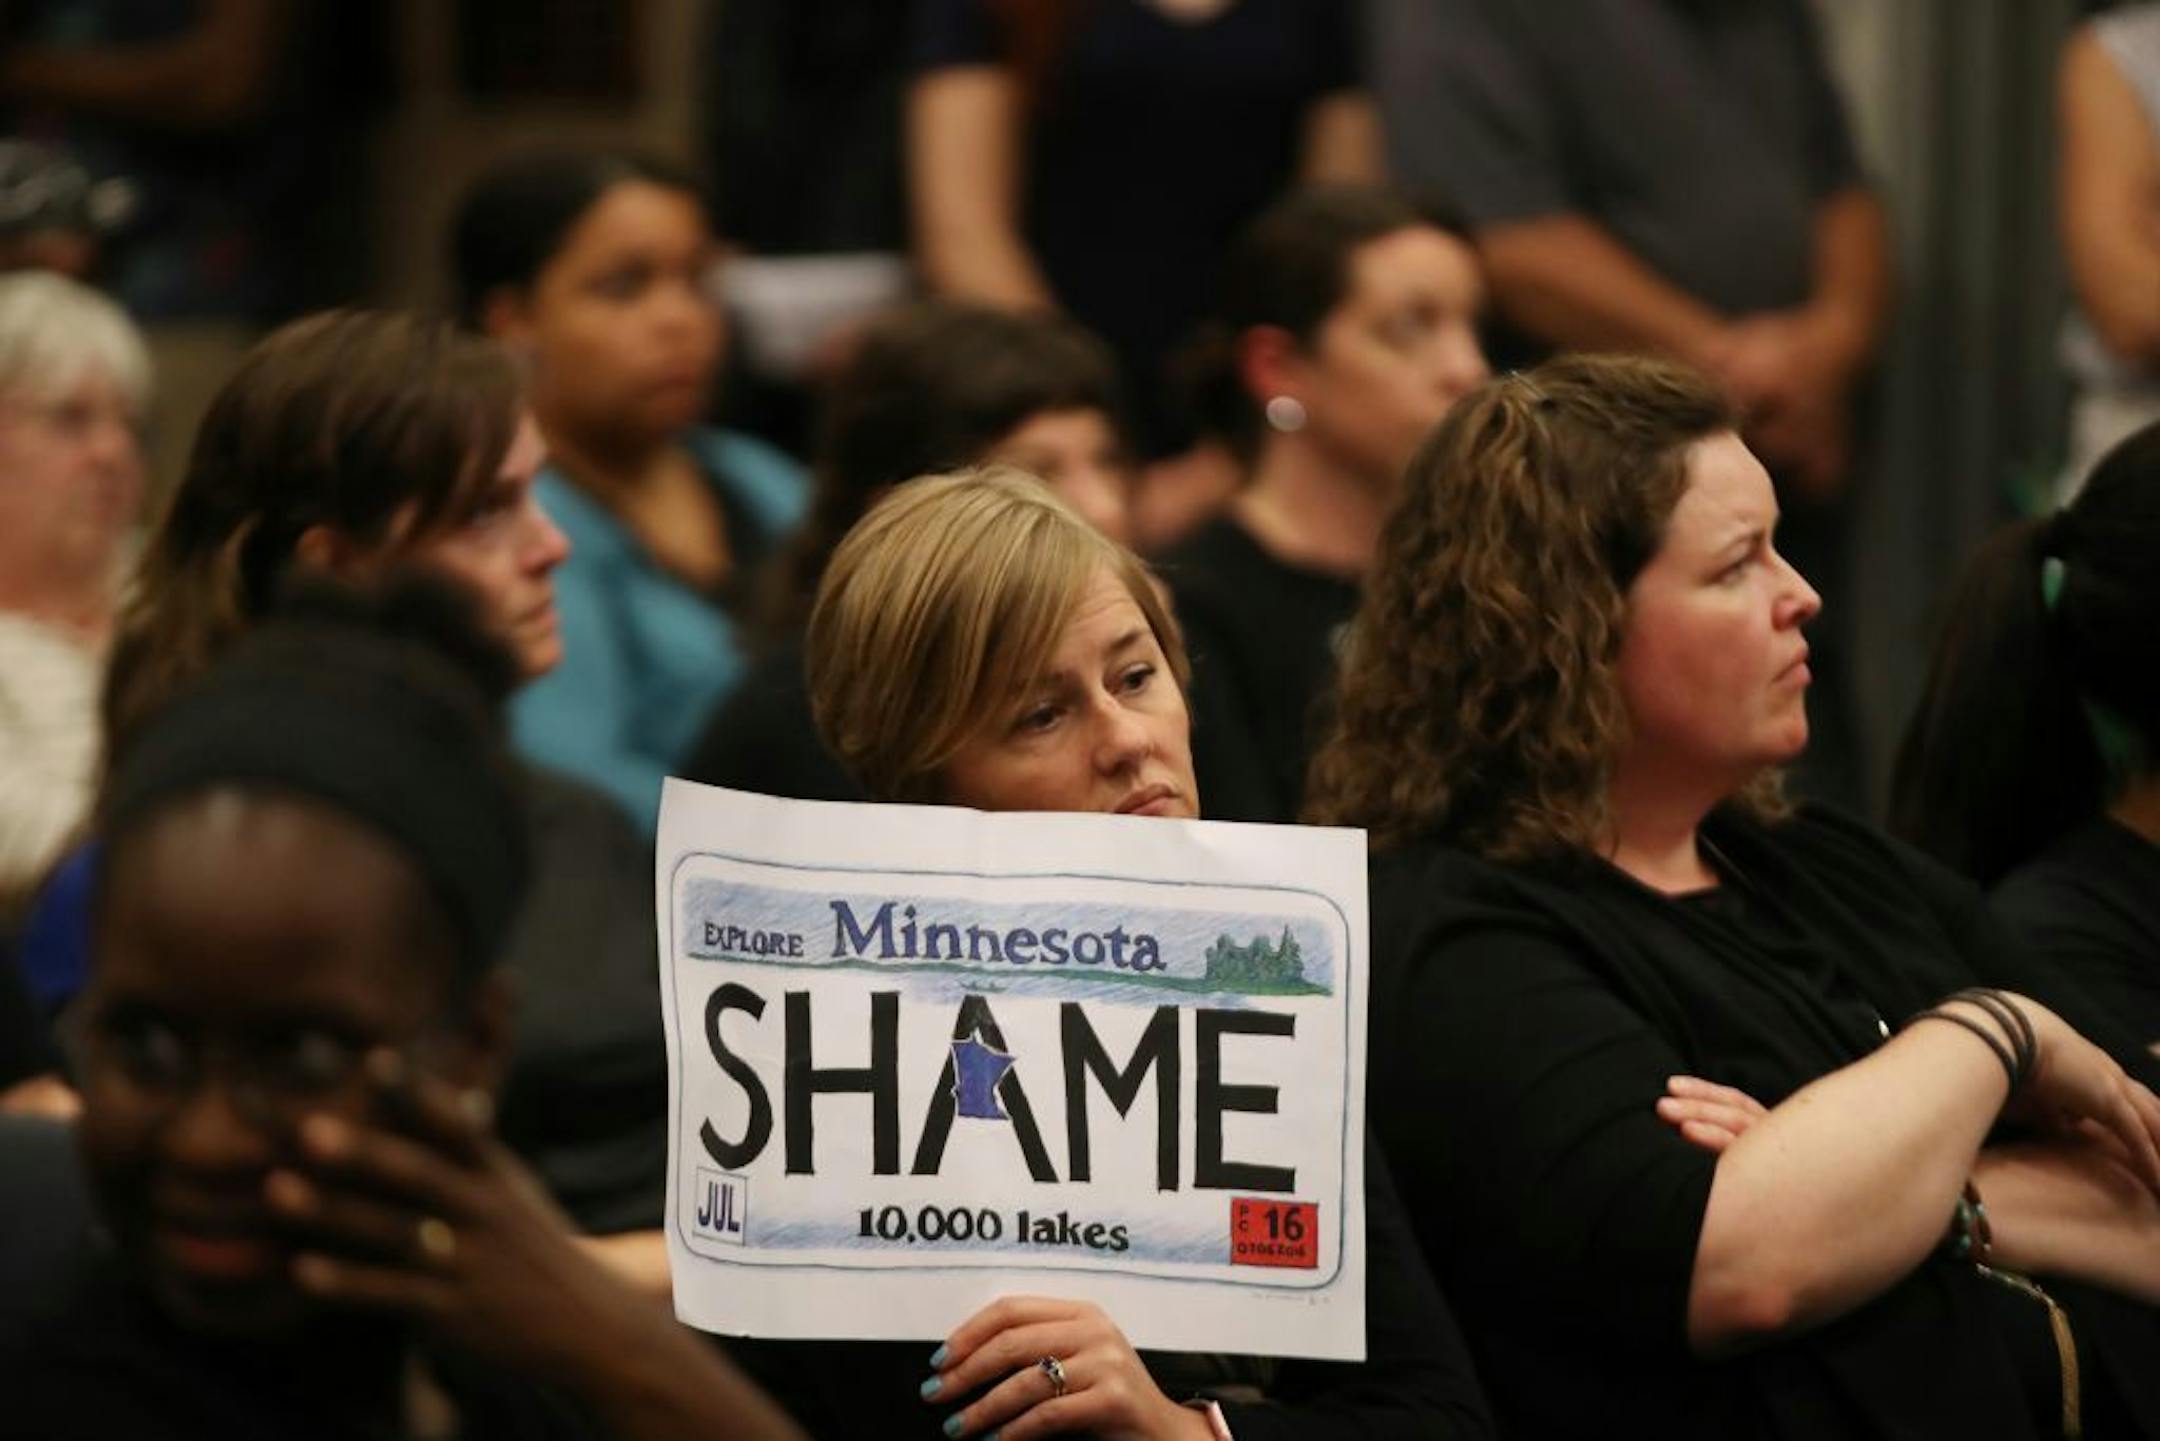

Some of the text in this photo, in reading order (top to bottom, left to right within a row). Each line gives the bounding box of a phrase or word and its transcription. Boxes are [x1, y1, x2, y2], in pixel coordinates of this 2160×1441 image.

[704, 900, 1168, 972] EXPLORE Minnesota
[700, 982, 1296, 1192] SHAME
[698, 1181, 739, 1232] JUL
[1017, 1210, 1129, 1250] lakes
[1263, 1206, 1305, 1241] 16
